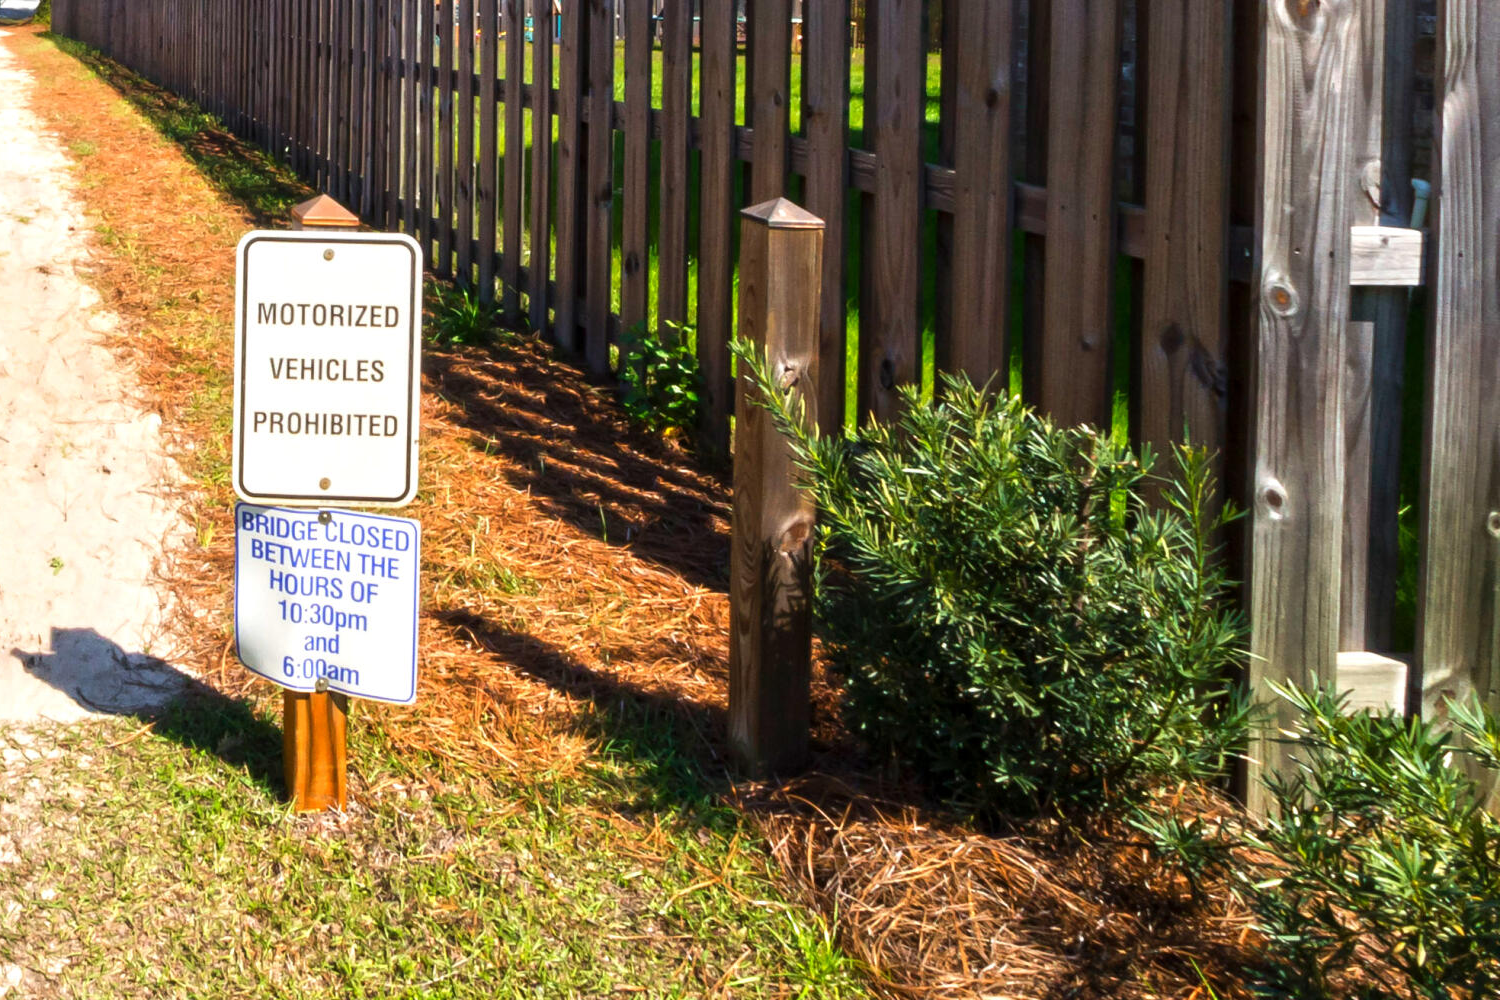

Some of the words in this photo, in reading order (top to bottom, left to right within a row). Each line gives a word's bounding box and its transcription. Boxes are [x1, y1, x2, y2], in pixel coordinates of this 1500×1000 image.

[257, 302, 399, 328] MOTORIZED
[269, 357, 385, 382] VEHICLES
[253, 411, 399, 437] PROHIBITED
[241, 510, 318, 541] BRIDGE
[325, 520, 410, 552] CLOSED
[251, 538, 351, 573] BETWEEN
[357, 553, 400, 580] THE
[269, 568, 343, 600] HOURS
[350, 580, 379, 604] OF
[278, 599, 368, 632] 10:30pm
[304, 634, 340, 655] and
[283, 655, 360, 686] 6:00am
